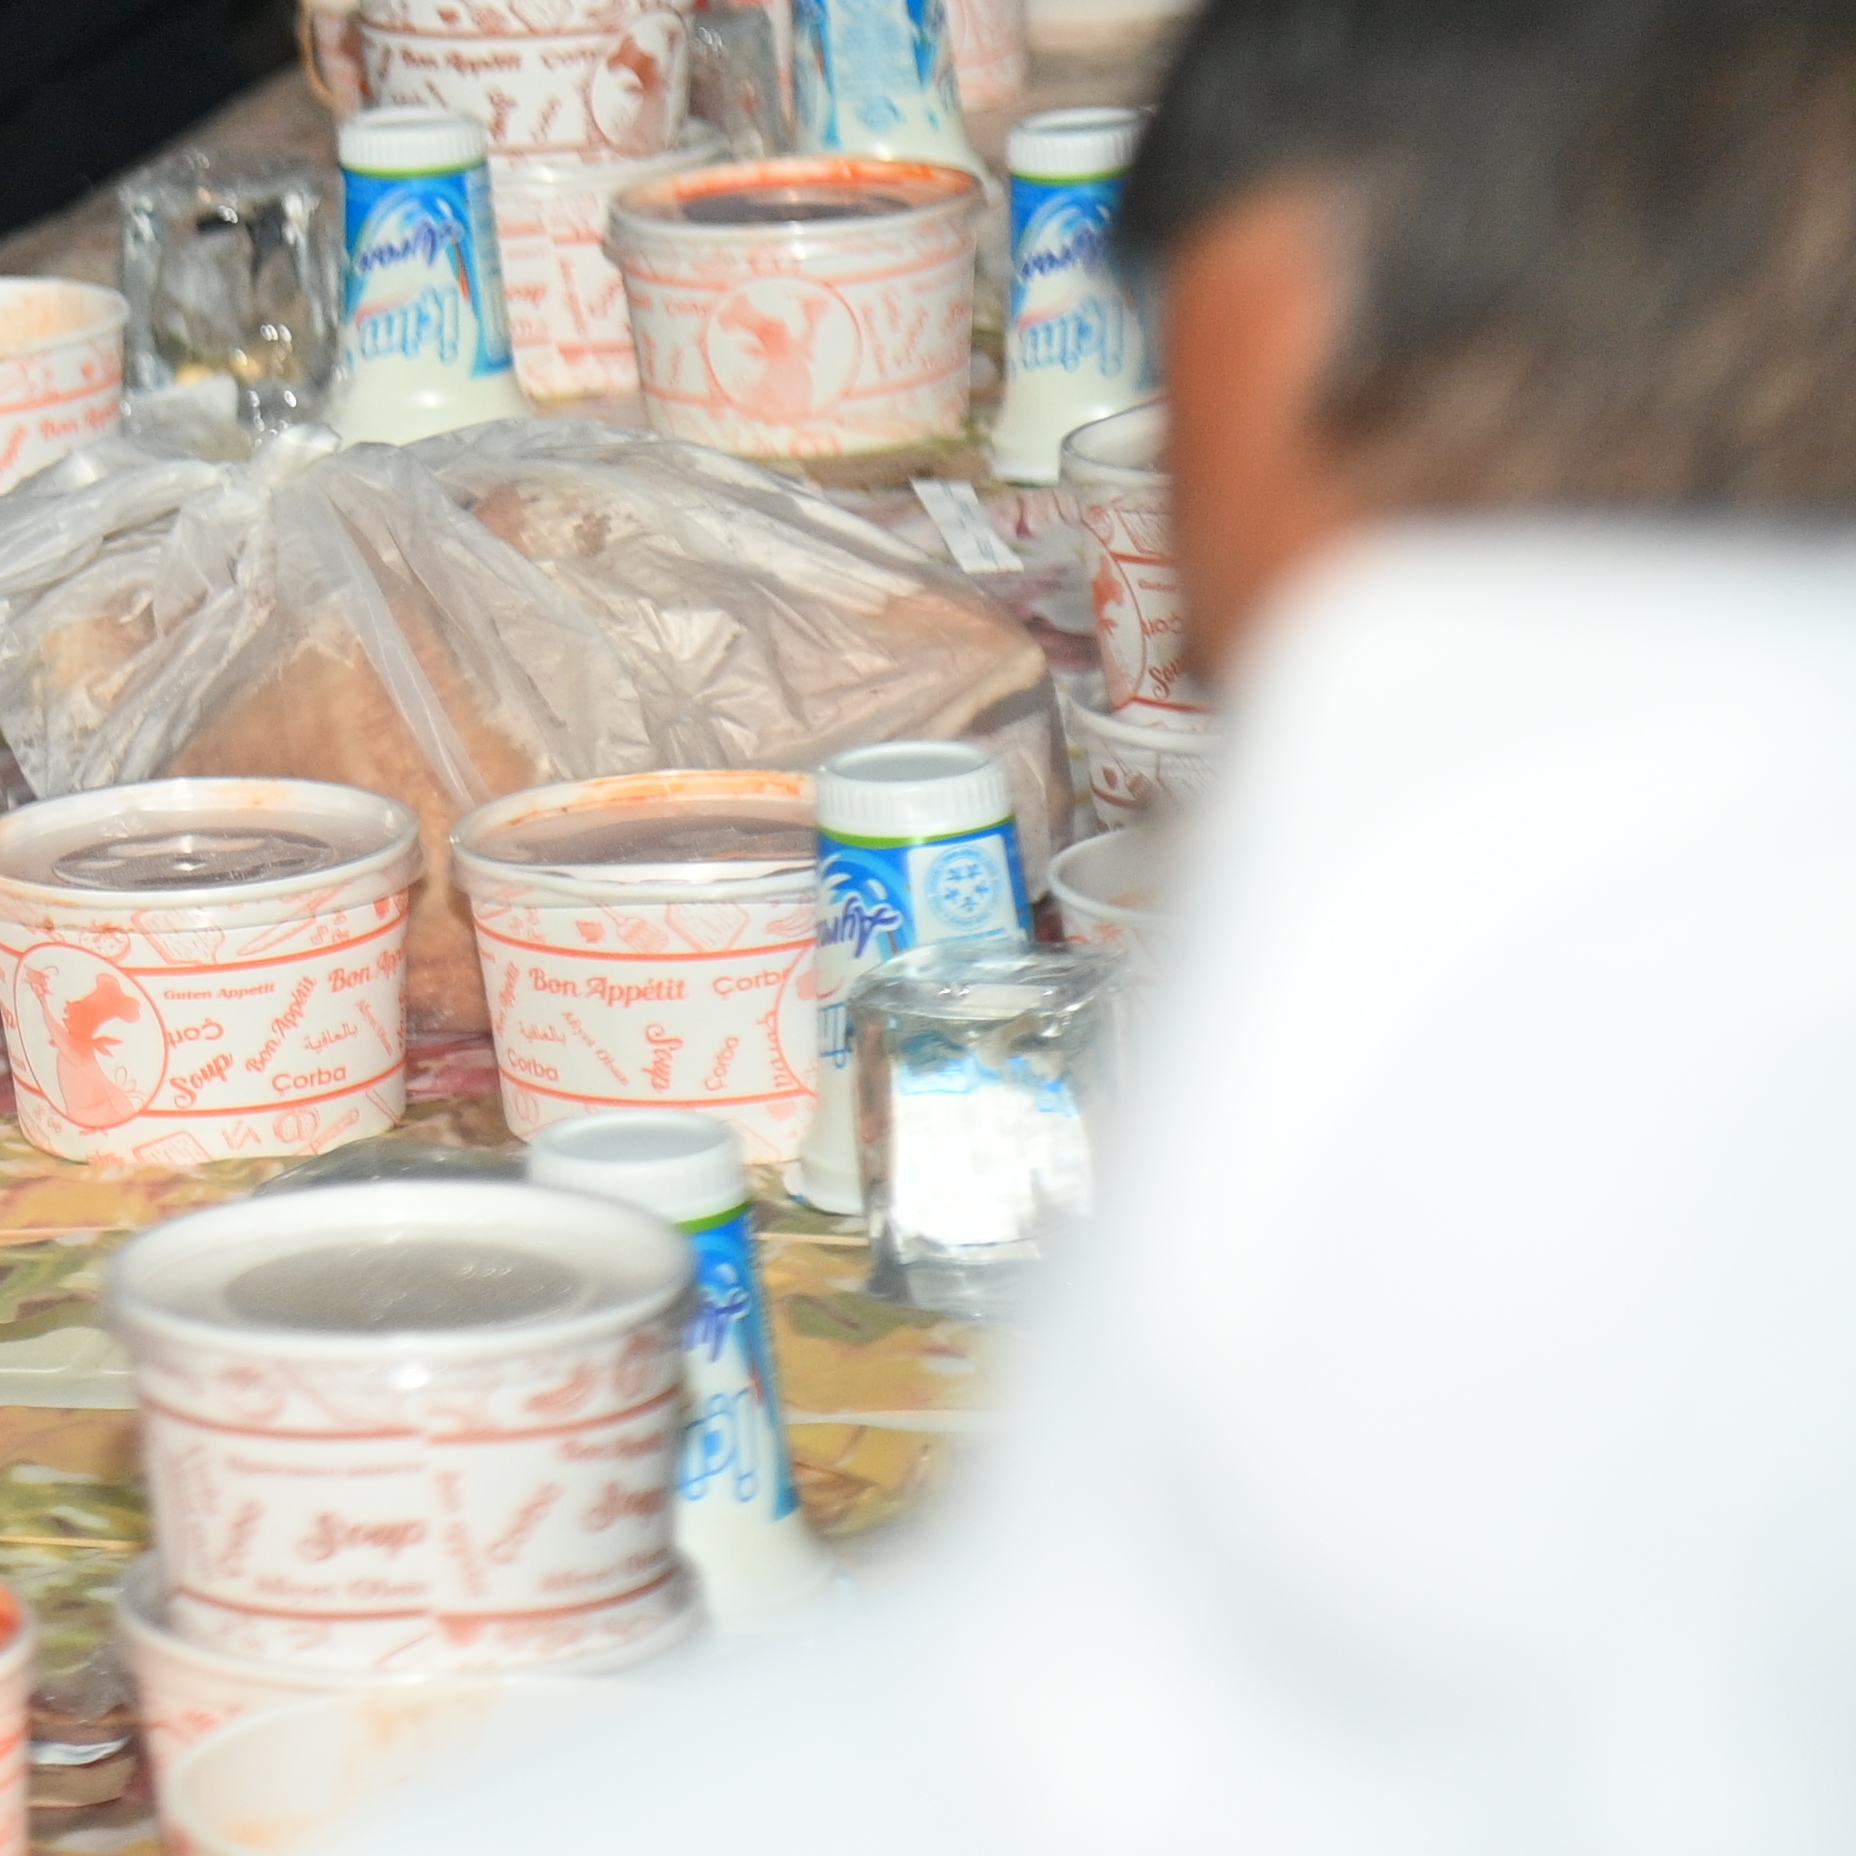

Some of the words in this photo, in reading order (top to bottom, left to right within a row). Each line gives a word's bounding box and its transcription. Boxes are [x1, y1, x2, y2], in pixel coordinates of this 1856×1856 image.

[528, 966, 580, 996] Bon
[584, 975, 689, 1008] Appétit
[169, 1052, 234, 1109] Soup
[271, 1066, 348, 1095] Çorba
[505, 1047, 561, 1082] Çorba
[640, 1022, 684, 1093] Soup
[703, 1036, 740, 1092] Çorba
